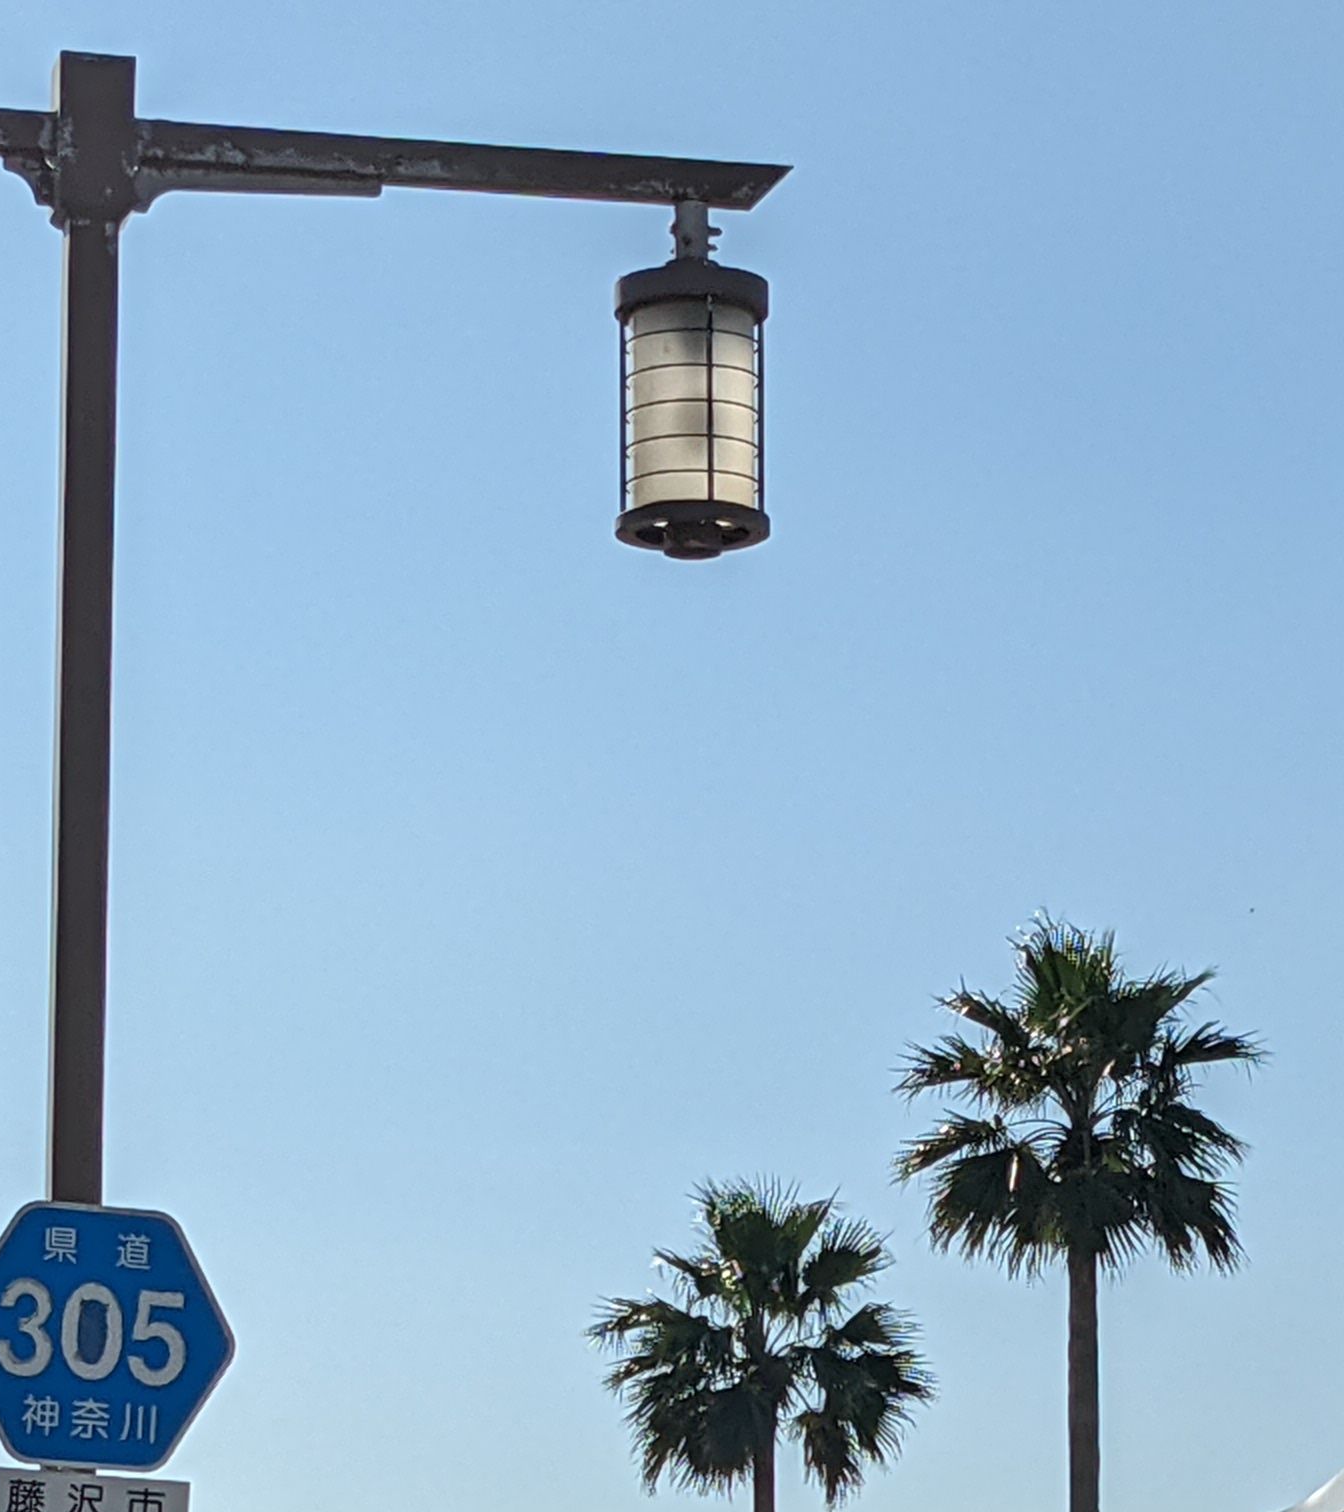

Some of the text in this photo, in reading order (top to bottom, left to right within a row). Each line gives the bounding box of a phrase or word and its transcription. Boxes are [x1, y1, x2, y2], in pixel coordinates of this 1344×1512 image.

[42, 1226, 152, 1271] 県道
[21, 1394, 158, 1444] 神奈川
